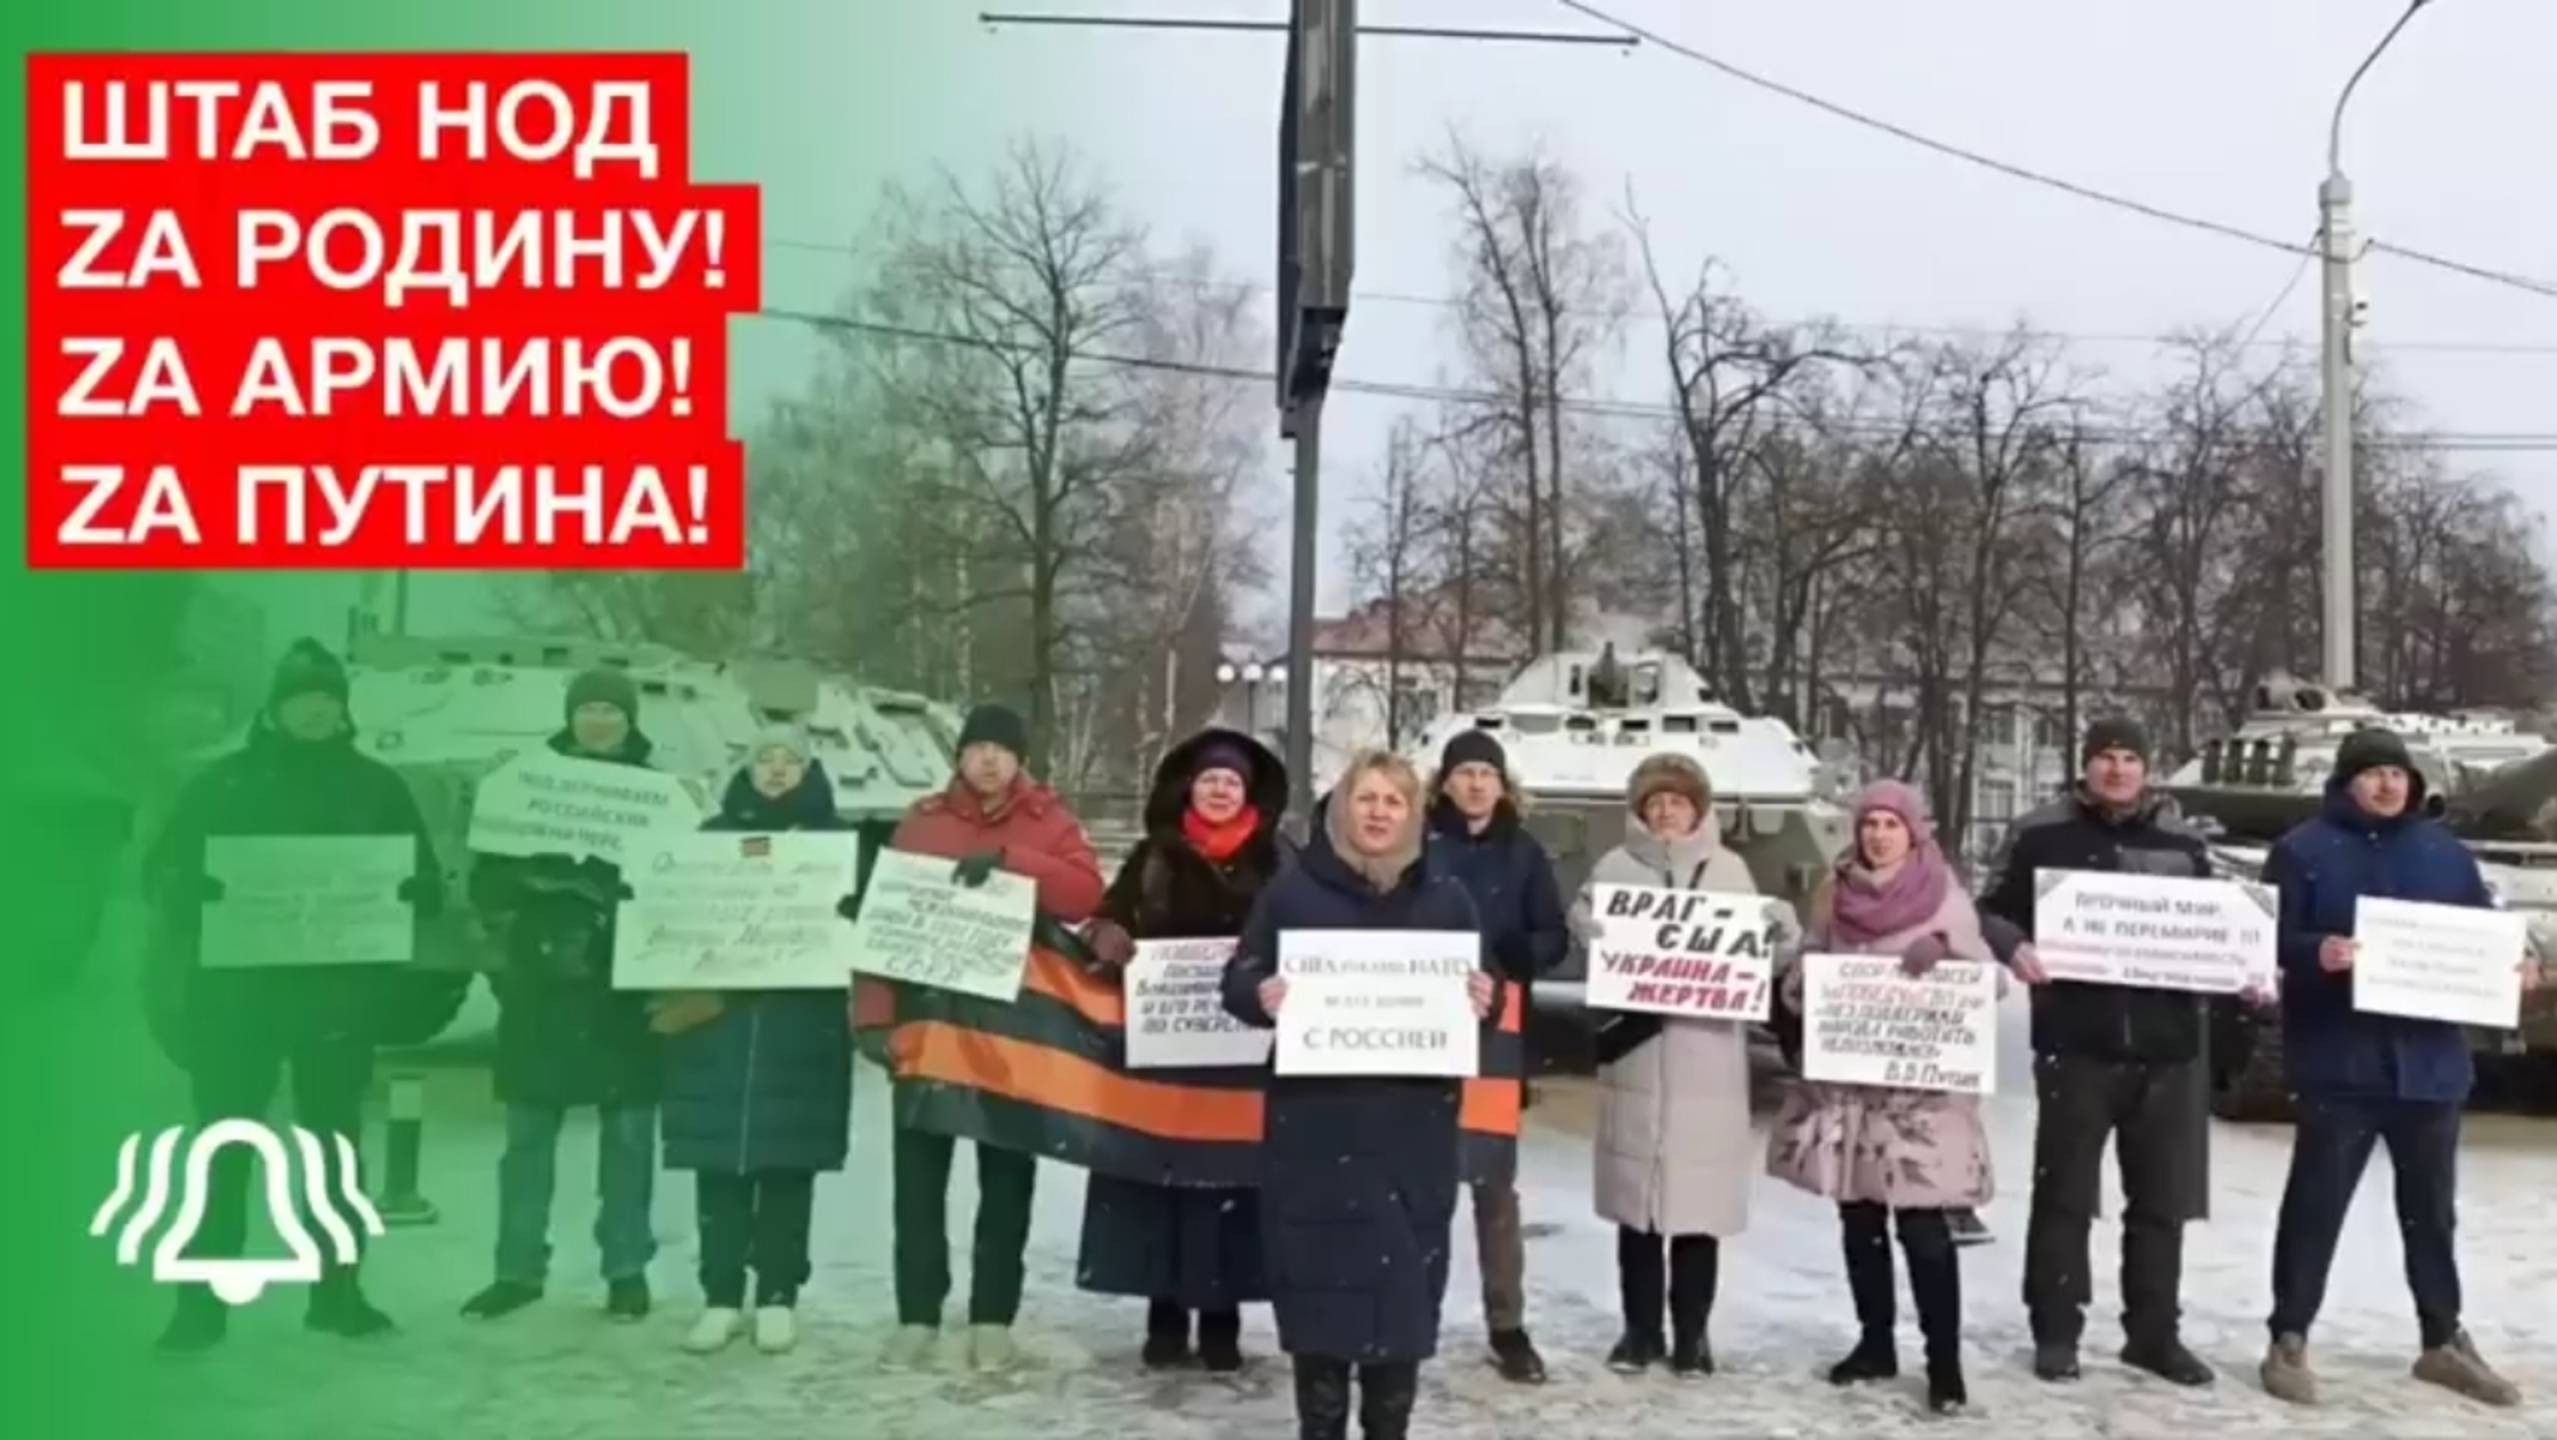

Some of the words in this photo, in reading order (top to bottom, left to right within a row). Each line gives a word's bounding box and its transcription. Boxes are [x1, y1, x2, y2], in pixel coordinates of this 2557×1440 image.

[1606, 889, 1708, 922] ВРАГ
[1656, 922, 1783, 960] США!
[2062, 917, 2076, 933] А
[2084, 920, 2106, 934] НЕ
[2115, 919, 2229, 944] ПЕРЕМИРИЕ
[1600, 950, 1731, 985] УКРАИНА
[1626, 980, 1767, 1012] ЖЕРТВА!
[1302, 1028, 1321, 1050] С
[1328, 1028, 1448, 1051] РОССИЕЙ
